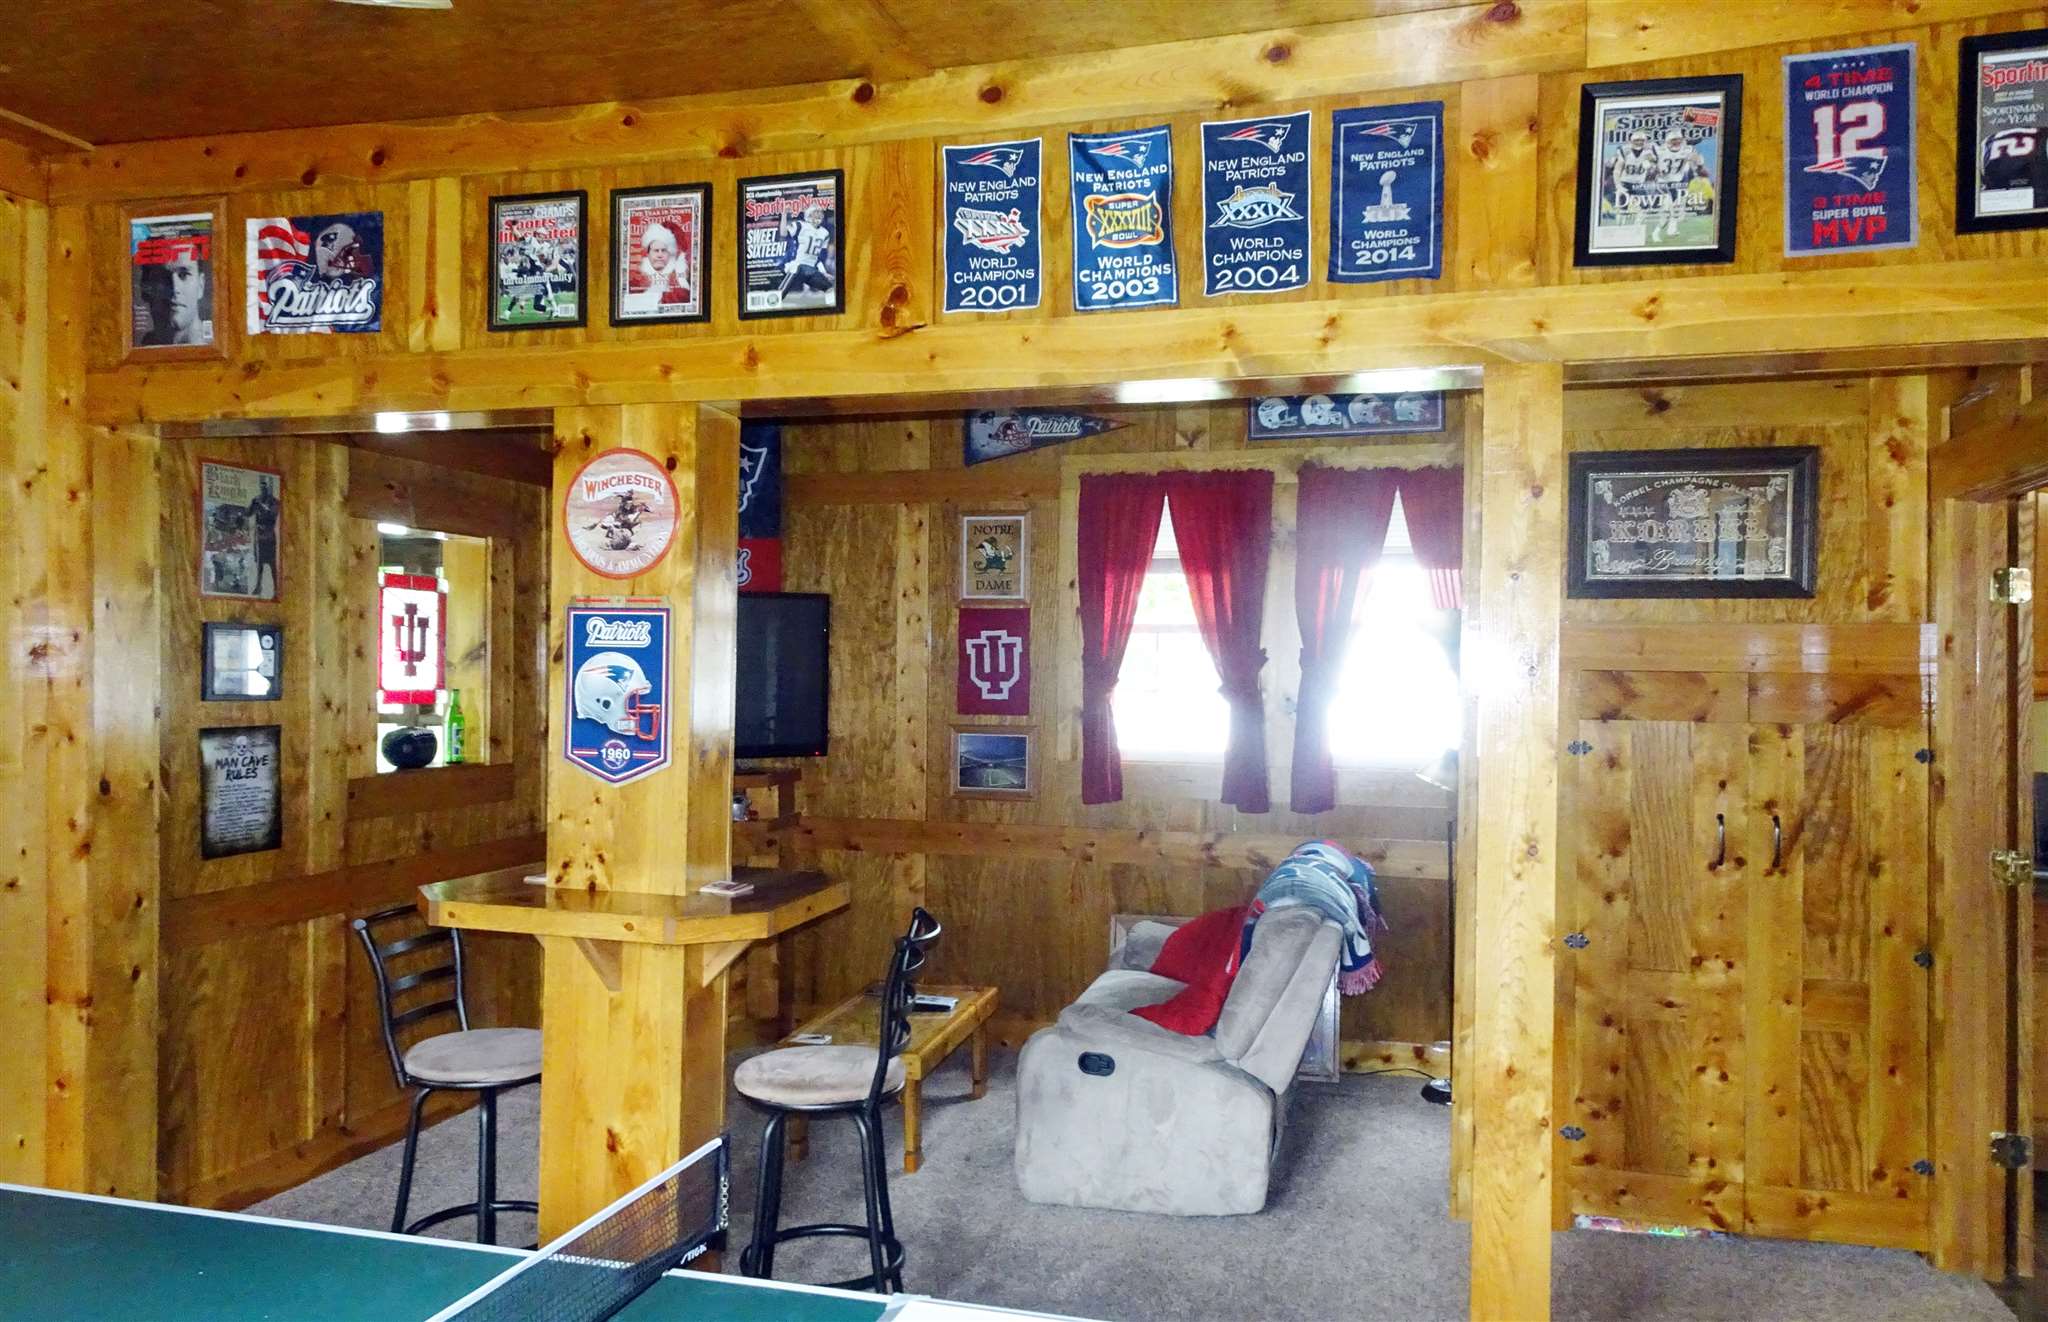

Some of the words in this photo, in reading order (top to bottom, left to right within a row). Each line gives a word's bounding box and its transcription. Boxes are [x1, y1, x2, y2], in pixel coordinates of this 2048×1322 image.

[1805, 74, 1821, 88] 4
[1829, 67, 1893, 85] TIME
[1805, 88, 1839, 101] WORLD
[1841, 83, 1894, 98] CHAMPION
[1616, 113, 1685, 132] Sports
[2008, 113, 2036, 124] YEAR
[1608, 125, 1714, 144] Illstrted
[1813, 100, 1887, 163] 12
[1208, 159, 1237, 171] NEW
[1241, 152, 1305, 168] ENGLAND
[1351, 153, 1375, 162] NEW
[1377, 148, 1424, 159] ENGLAND
[1076, 171, 1104, 182] NEW
[1108, 164, 1168, 180] ENGLAND
[1359, 158, 1415, 171] PATRIOTS
[1662, 158, 1685, 176] 37
[1225, 166, 1286, 181] PATRIOTS
[950, 182, 977, 192] NEW
[979, 176, 1036, 191] ENGLAND
[1093, 178, 1151, 192] PATRIOTS
[965, 190, 1019, 202] PATRIOTS
[1109, 200, 1138, 209] SUPER
[1676, 188, 1706, 206] Pat
[1813, 197, 1828, 207] 3
[1833, 192, 1887, 206] TIME
[534, 203, 576, 219] CHAMPS
[1215, 197, 1297, 224] XXXIX
[1812, 208, 1848, 220] SUPER
[1852, 205, 1886, 218] BOWL
[1099, 204, 1152, 235] XXXVIII
[747, 227, 778, 245] SWEET
[1112, 231, 1138, 241] BOWL
[1364, 229, 1408, 240] WORLD
[1812, 217, 1888, 246] MVP
[747, 241, 787, 259] SIXTEEN!
[1230, 237, 1284, 250] WORLD
[1351, 236, 1421, 249] CHAMPIONS
[969, 257, 1017, 269] WORLD
[1097, 254, 1153, 267] WORLD
[1213, 249, 1303, 266] CHAMPIONS
[1355, 245, 1416, 265] 2014
[954, 269, 1034, 283] CHAMPIONS
[1079, 263, 1172, 283] CHAMPIONS
[1215, 264, 1300, 289] 2004
[960, 284, 1026, 307] 2001
[1091, 277, 1159, 300] 2003
[267, 277, 376, 328] Patriots
[1027, 416, 1083, 438] Patriots
[584, 474, 663, 500] WINCHESTER
[1653, 476, 1720, 489] CHAMPAGNE
[973, 524, 1014, 537] NOTRE
[1608, 518, 1770, 544] KORBEL
[1651, 548, 1726, 573] Brandy
[975, 579, 1013, 591] DAME
[585, 617, 652, 648] Patriots
[215, 757, 240, 769] MAN
[241, 755, 269, 768] CAVE
[600, 747, 631, 761] 1960
[225, 767, 259, 782] RULES
